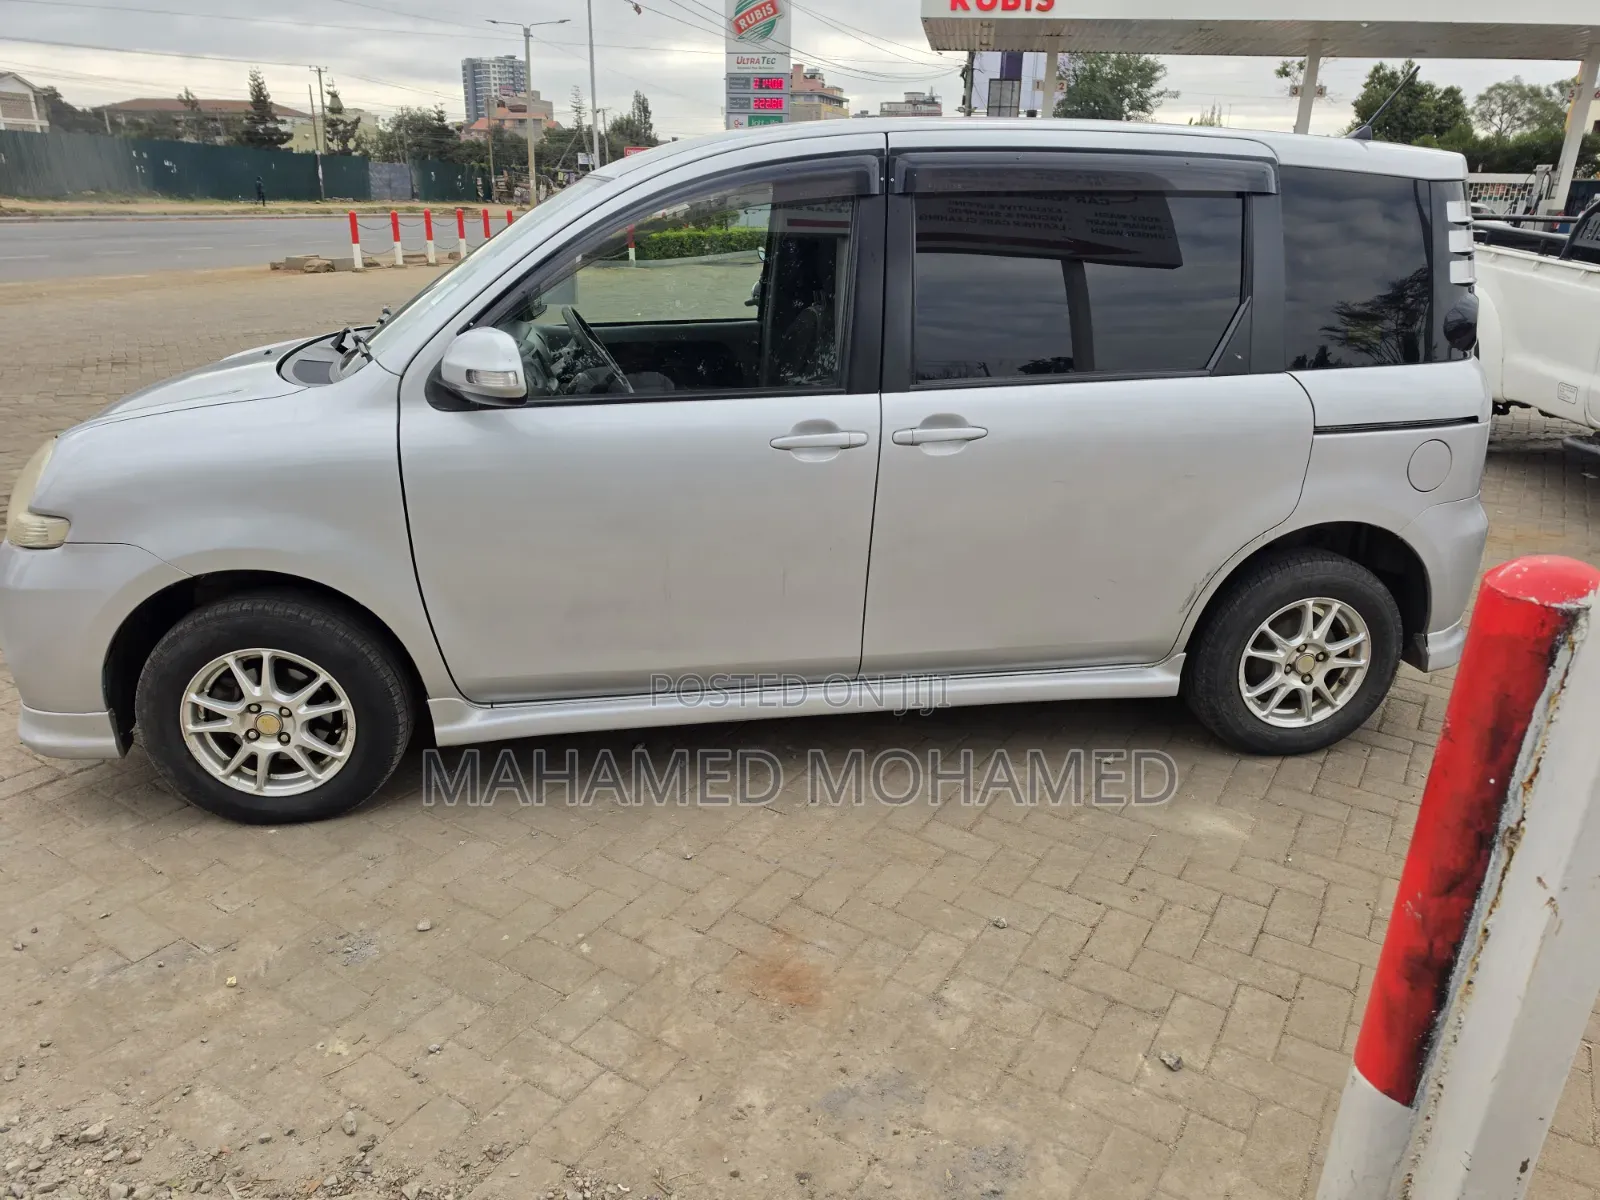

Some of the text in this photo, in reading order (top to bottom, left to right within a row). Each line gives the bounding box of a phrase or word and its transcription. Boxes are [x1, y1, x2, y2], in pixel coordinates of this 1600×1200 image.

[1059, 82, 1065, 91] 2
[1291, 87, 1298, 96] 3
[1316, 87, 1323, 96] 4
[1568, 89, 1575, 98] 5
